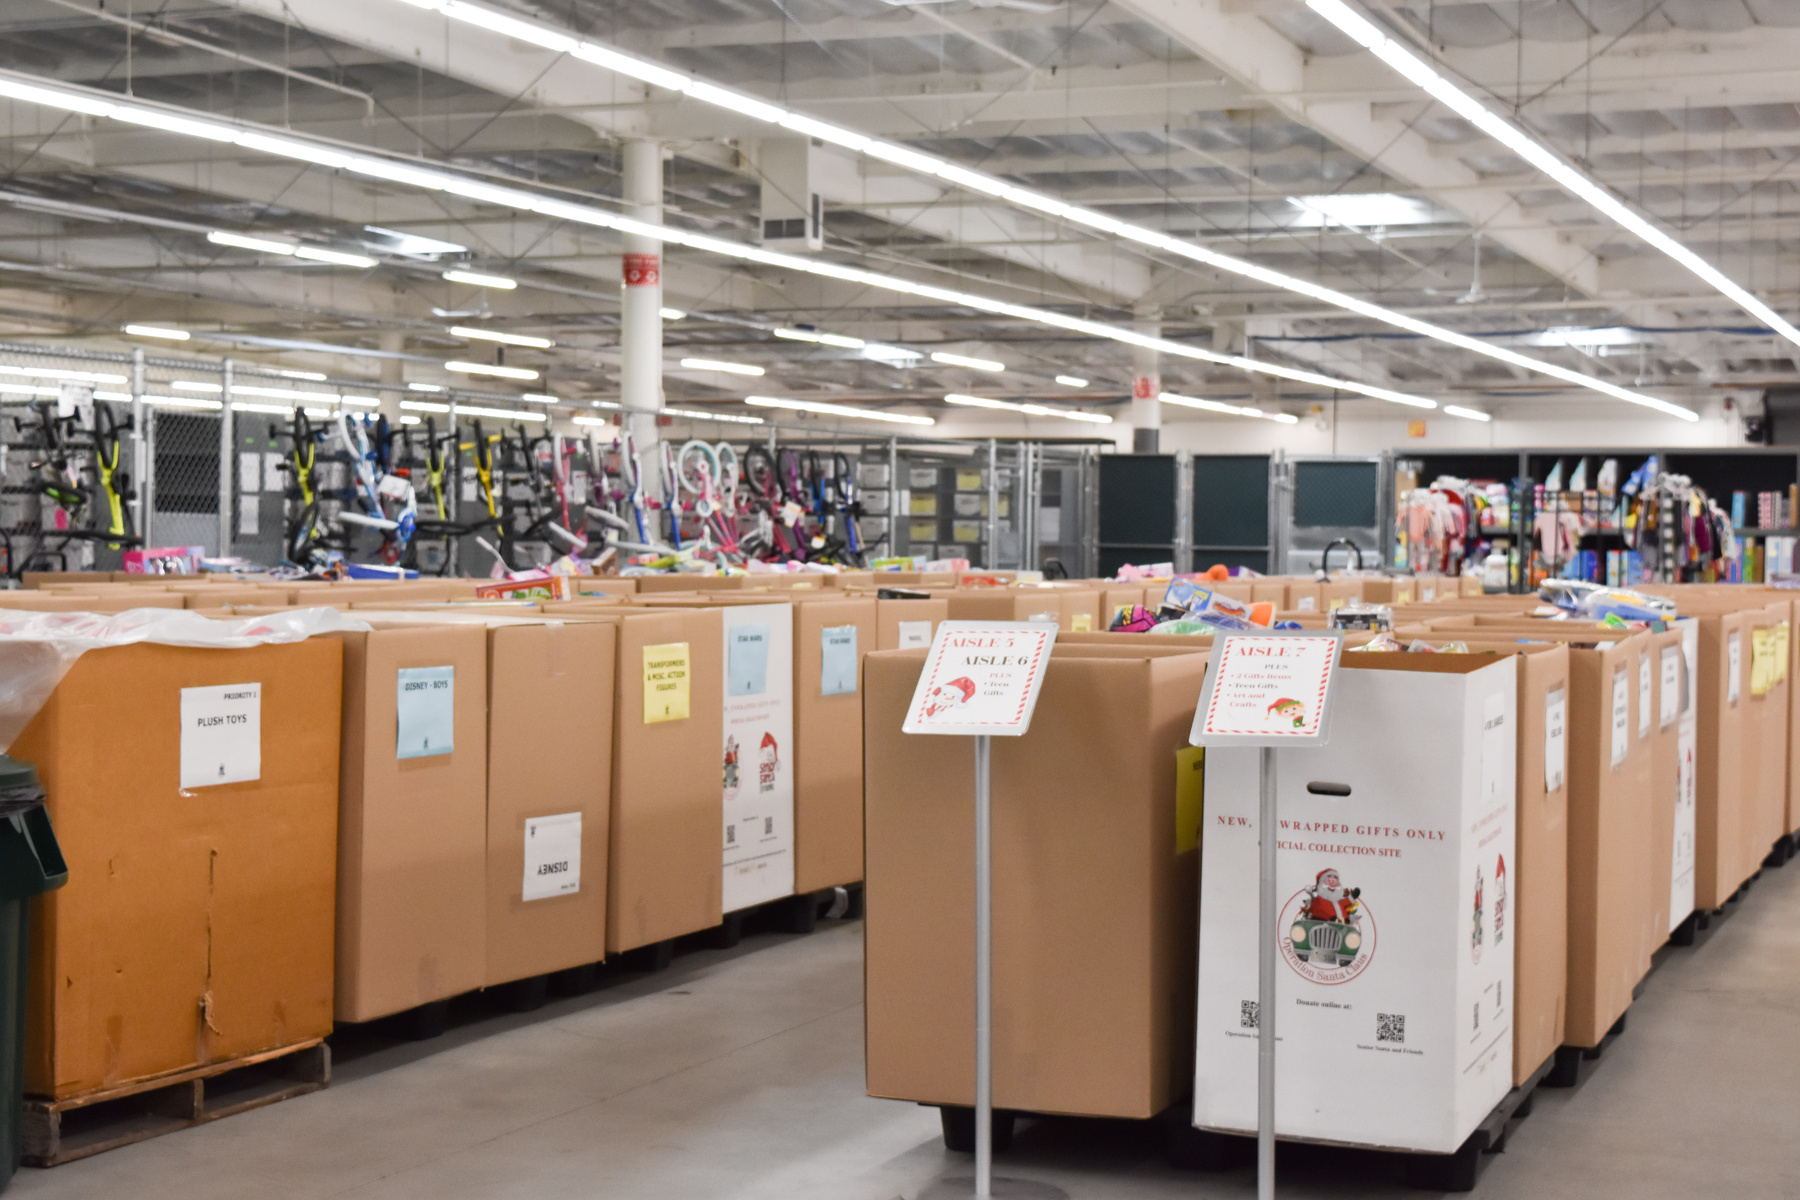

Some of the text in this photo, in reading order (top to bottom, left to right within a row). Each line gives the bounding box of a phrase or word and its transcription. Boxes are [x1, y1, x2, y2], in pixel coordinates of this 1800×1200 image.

[950, 638, 1015, 648] AISLE 5
[1235, 647, 1307, 657] AISLE 7
[961, 656, 1028, 666] AISLE 6
[405, 681, 427, 691] DISNEY
[433, 680, 449, 689] BOYS
[224, 692, 252, 700] PRIORITY
[197, 714, 247, 727] PLUSH TOYS
[1217, 816, 1447, 841] NEW, WRAPPED GIFTS ONLY
[1308, 843, 1376, 856] COLLECTION
[1378, 848, 1402, 858] SITE
[537, 861, 568, 875] DISNEY
[1283, 936, 1368, 981] Operation Santa Claus
[1296, 998, 1319, 1007] Donate
